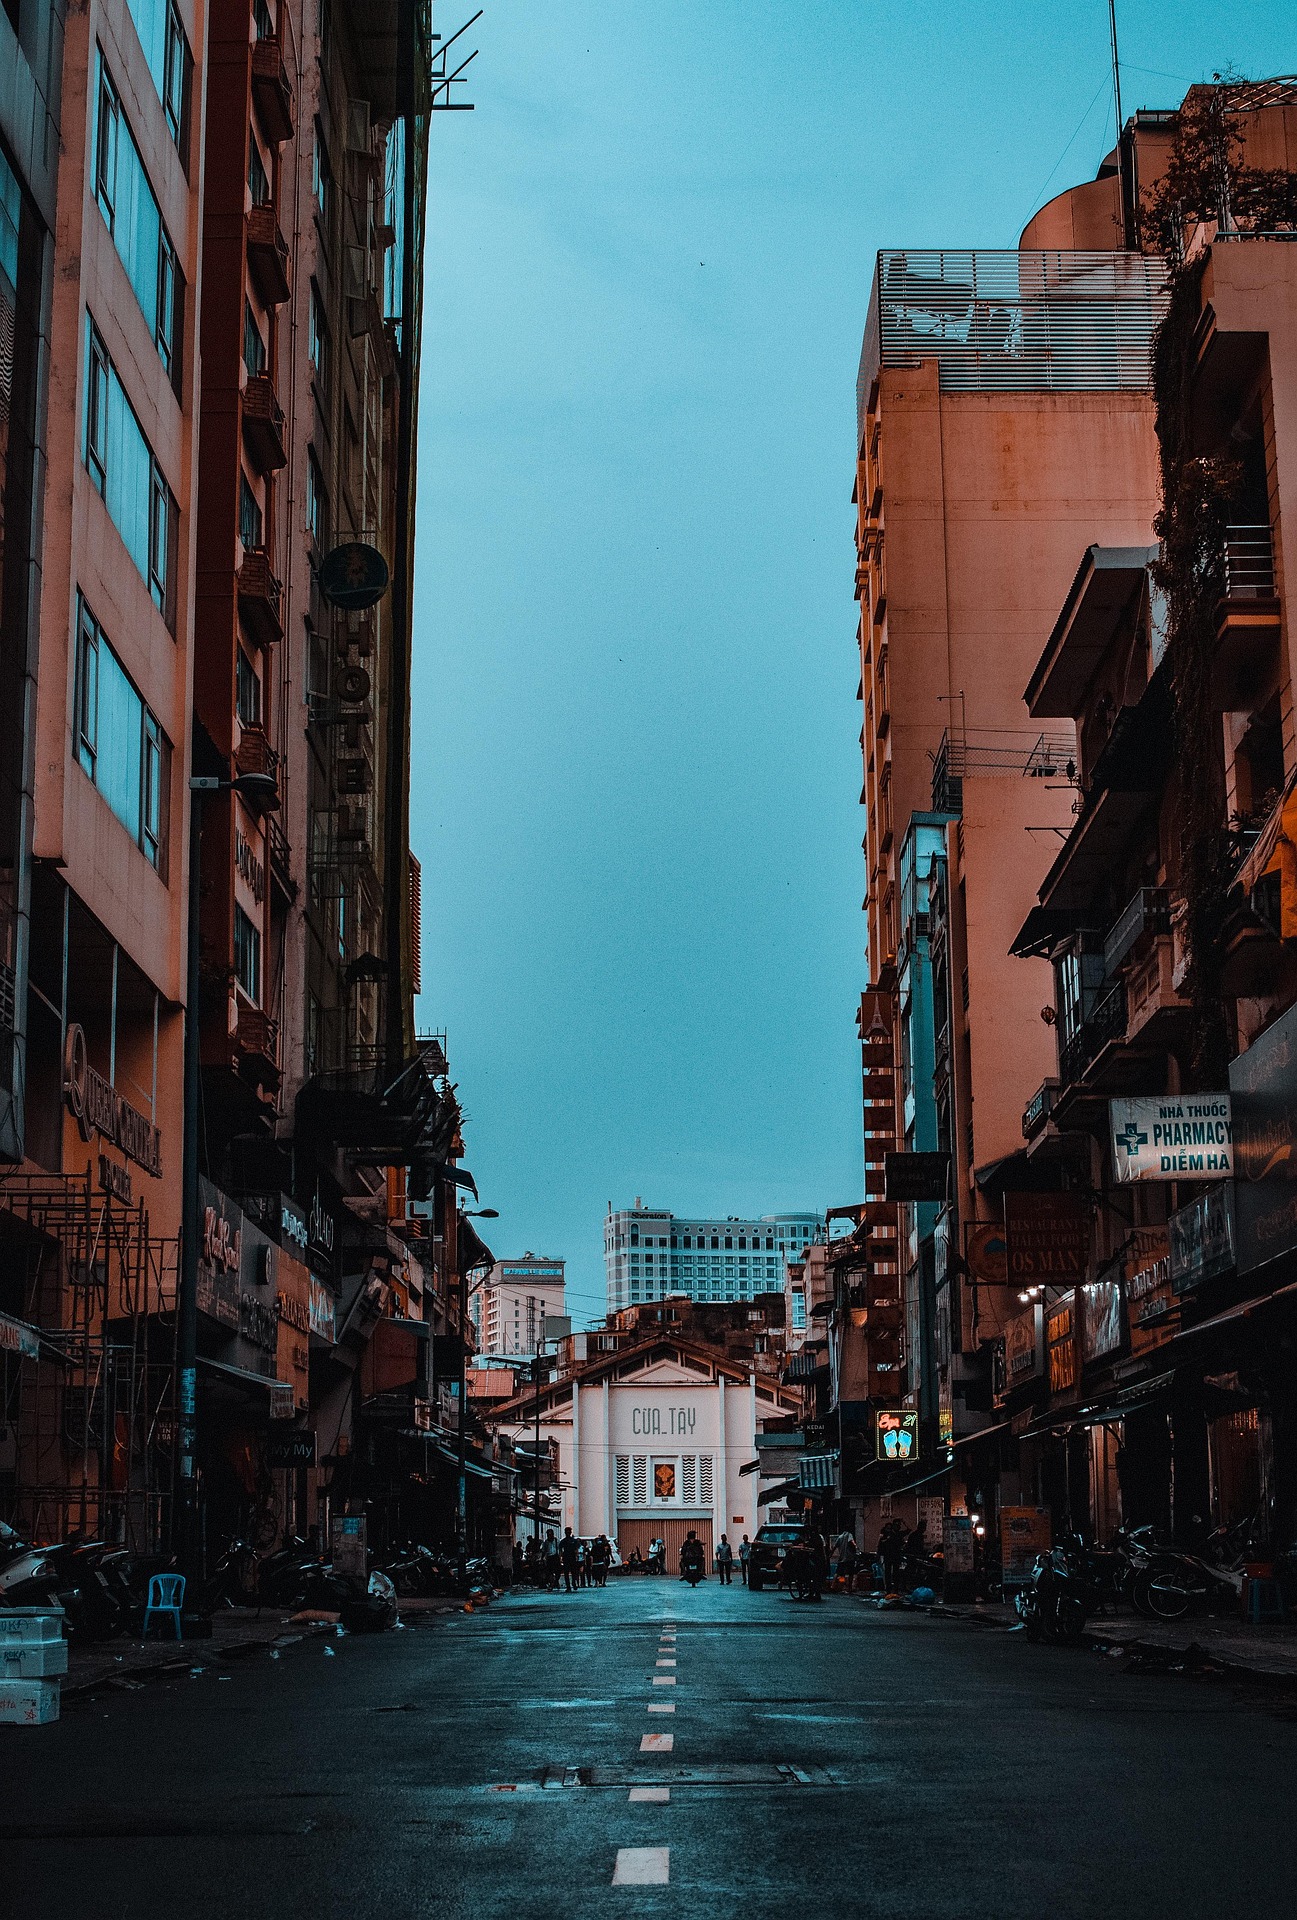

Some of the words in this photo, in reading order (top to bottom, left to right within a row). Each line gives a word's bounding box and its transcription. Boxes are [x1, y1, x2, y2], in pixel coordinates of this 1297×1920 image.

[337, 621, 371, 842] HOTEL
[1159, 1103, 1184, 1118] NHÀ
[1186, 1101, 1227, 1117] THUỐC
[1153, 1121, 1233, 1146] PHARMACY
[1160, 1149, 1204, 1172] DIỄM
[1207, 1149, 1231, 1170] HÀ
[631, 1211, 667, 1220] Sheraton
[293, 1443, 313, 1459] My
